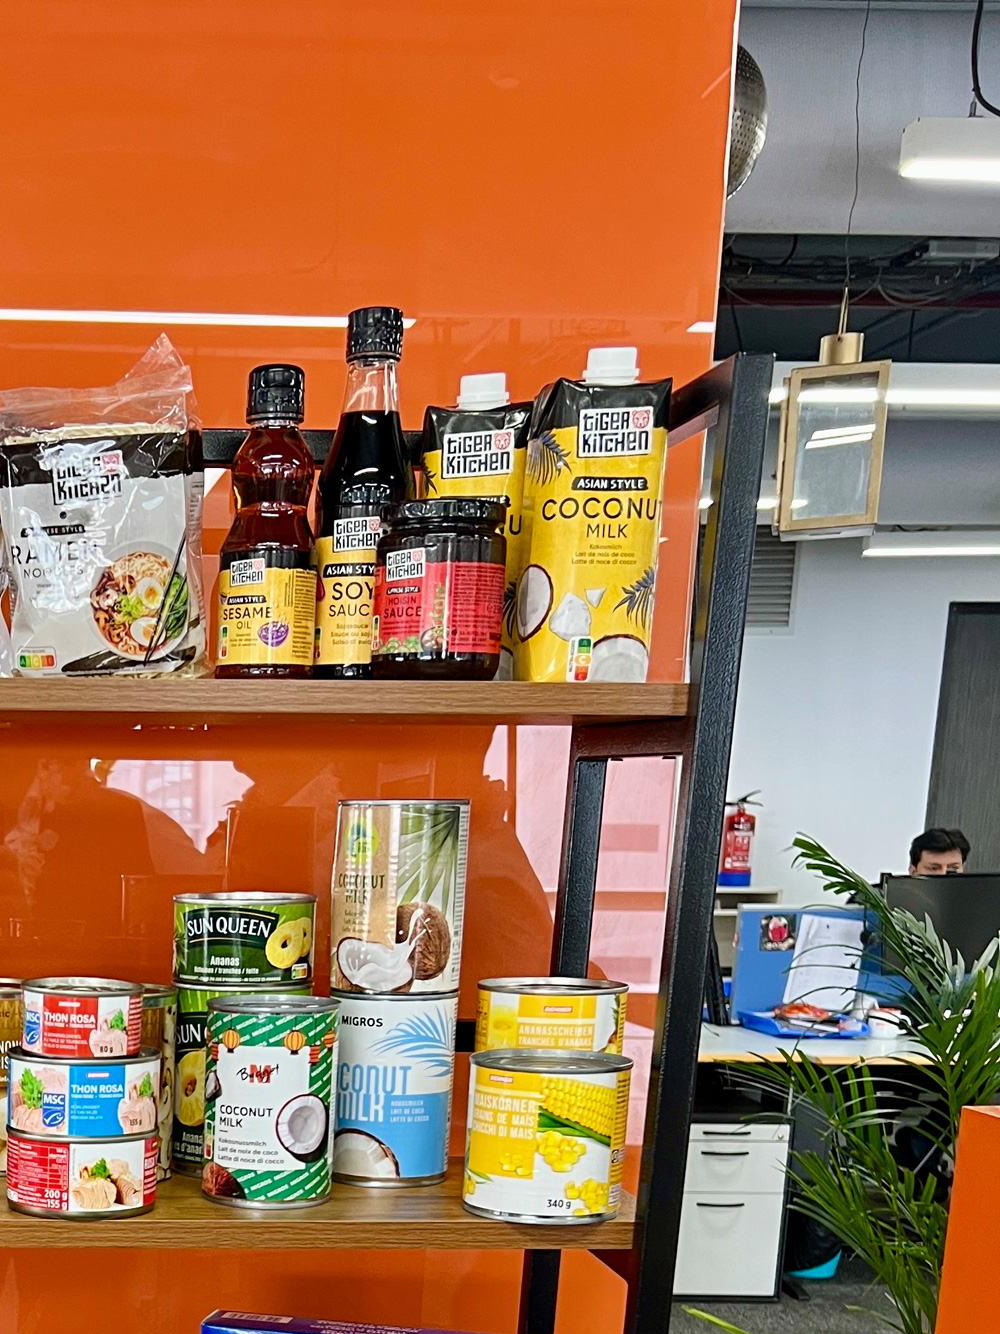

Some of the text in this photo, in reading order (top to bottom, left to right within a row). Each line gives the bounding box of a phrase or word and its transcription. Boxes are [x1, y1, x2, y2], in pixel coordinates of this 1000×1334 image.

[578, 479, 644, 489] ASIAN STYLE
[542, 498, 659, 520] COCONU
[587, 524, 628, 538] MILK
[327, 566, 352, 574] ASIAN
[223, 608, 272, 620] SESAME
[384, 607, 421, 619] SAUCE
[187, 917, 271, 937] SUN QUEEN
[210, 956, 239, 966] Ananas
[26, 1013, 39, 1023] MSC
[44, 1012, 95, 1023] THON ROSA
[342, 1016, 383, 1027] MIGROS
[519, 1024, 593, 1036] ANANASSCHEIBEN
[518, 1037, 555, 1046] TRANCHES
[71, 1085, 123, 1094] THON ROSA
[44, 1094, 64, 1104] MSC
[475, 1092, 535, 1112] MAISKÖRNER
[220, 1105, 273, 1117] COCONUT
[220, 1117, 242, 1128] MILK
[497, 1114, 507, 1123] DE
[498, 1126, 534, 1140] DI MAIS
[219, 1137, 266, 1146] Kokosnussmilch
[44, 1190, 60, 1198] 200
[47, 1199, 60, 1208] 155
[547, 1199, 563, 1208] 340
